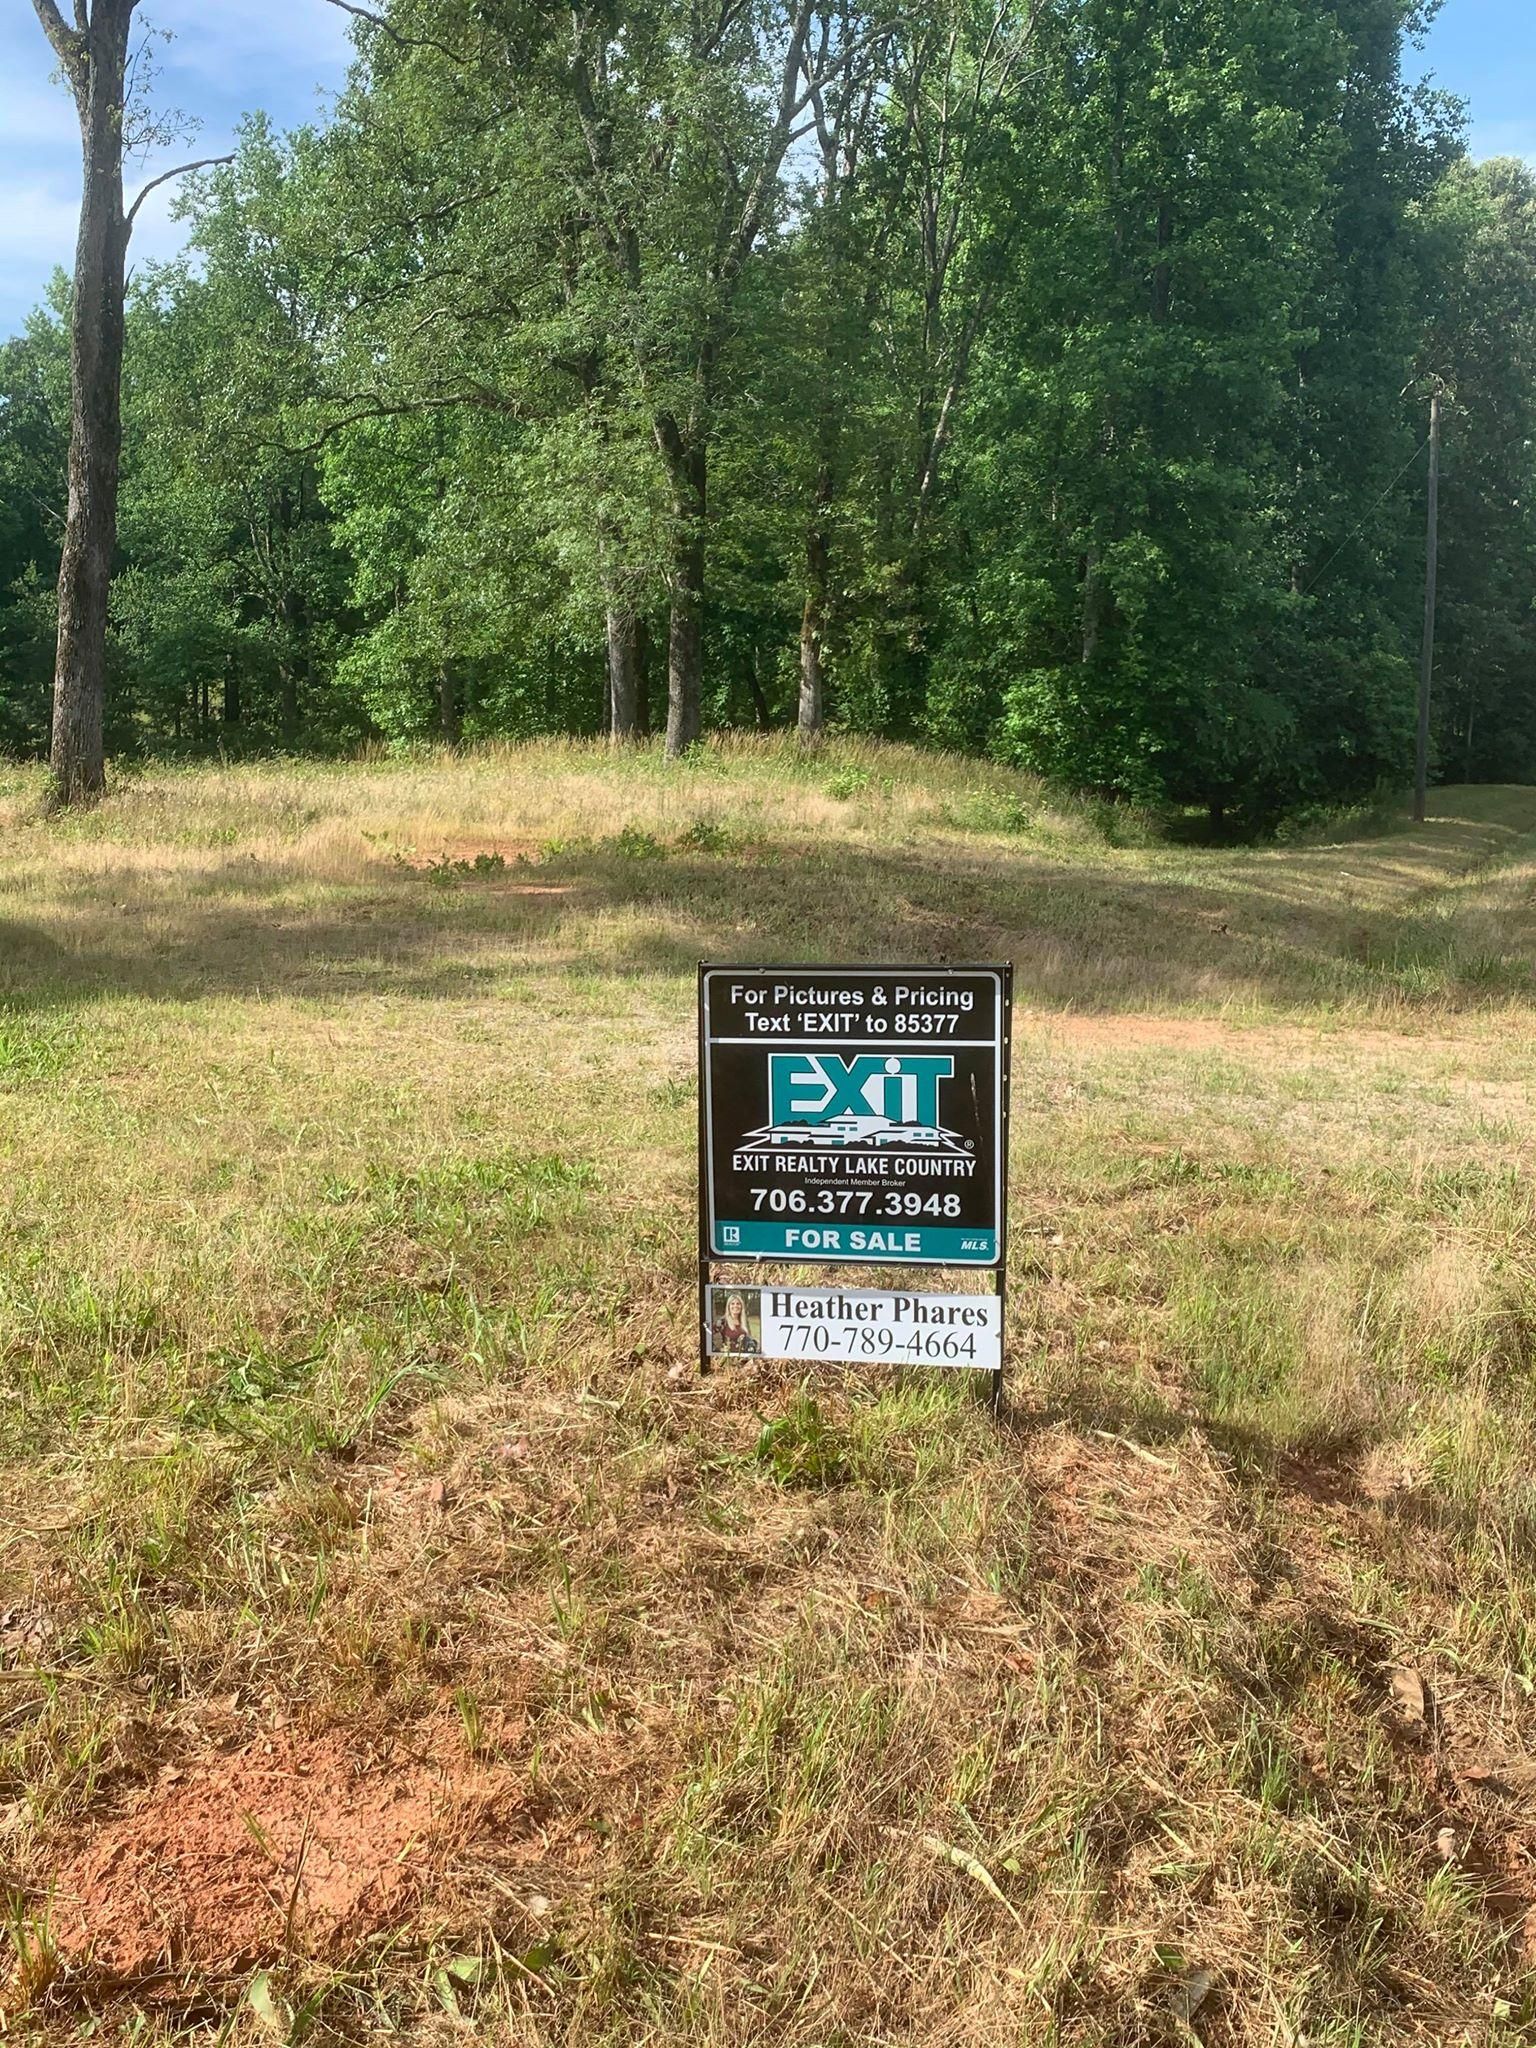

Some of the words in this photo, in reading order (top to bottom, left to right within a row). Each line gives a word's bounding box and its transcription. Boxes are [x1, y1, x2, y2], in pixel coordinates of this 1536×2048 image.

[731, 985, 767, 1005] For
[774, 985, 864, 1006] Pictures
[871, 986, 888, 1006] &
[895, 986, 974, 1011] Pricing
[745, 1012, 790, 1032] Text
[866, 1014, 888, 1033] to
[894, 1013, 959, 1034] 85377
[732, 1154, 769, 1172] EXIT
[775, 1156, 840, 1174] REALTY
[846, 1157, 888, 1175] LAKE
[895, 1158, 976, 1177] COUNTRY
[804, 1177, 849, 1186] Independent
[851, 1178, 880, 1187] Member
[881, 1179, 905, 1188] Broker
[750, 1188, 961, 1217] 706.377.3948
[785, 1228, 841, 1249] FOR
[850, 1230, 921, 1252] SALE
[770, 1292, 883, 1322] Heather
[892, 1297, 988, 1327] Phares
[778, 1324, 977, 1360] 770-789-4664
